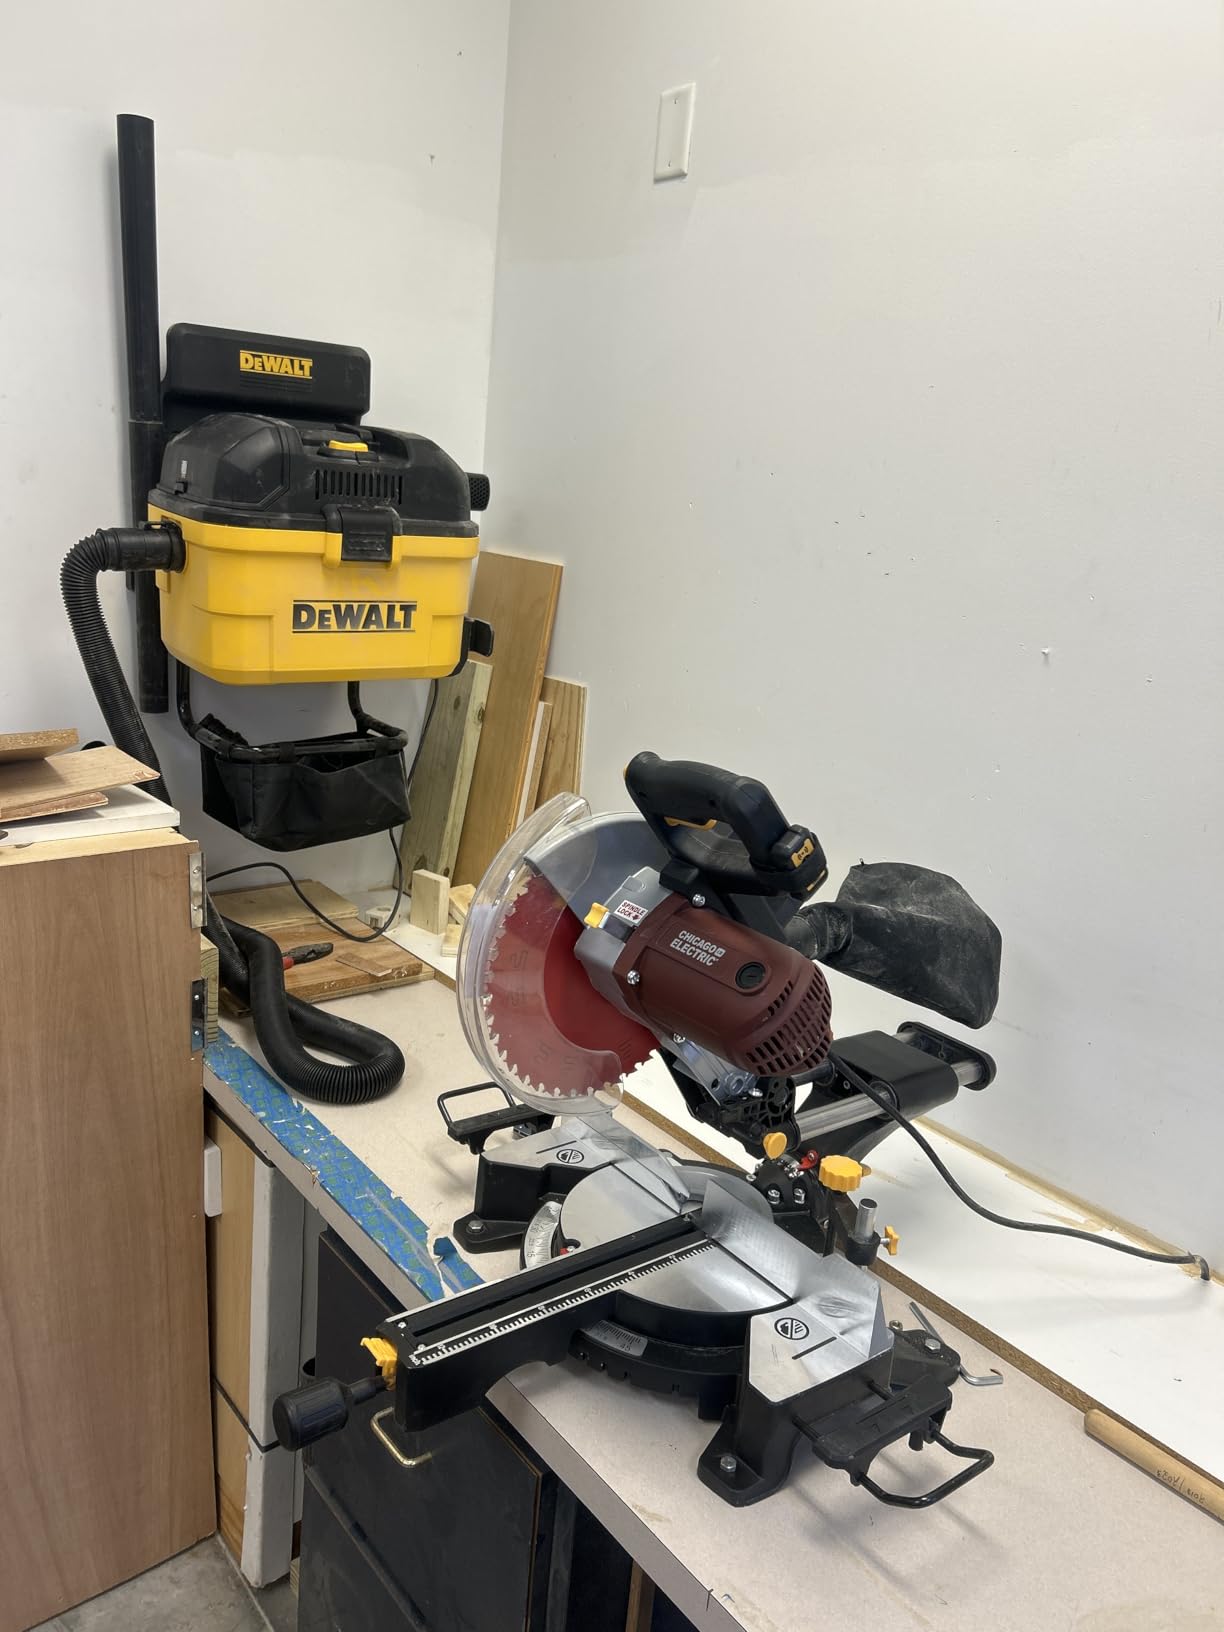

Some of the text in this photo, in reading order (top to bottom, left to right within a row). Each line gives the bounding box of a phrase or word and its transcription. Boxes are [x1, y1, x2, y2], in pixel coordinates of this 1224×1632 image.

[616, 907, 633, 918] LOCK
[621, 901, 646, 916] SPINDLE
[678, 930, 717, 954] CHICAGO
[669, 938, 717, 967] ELECTRIC
